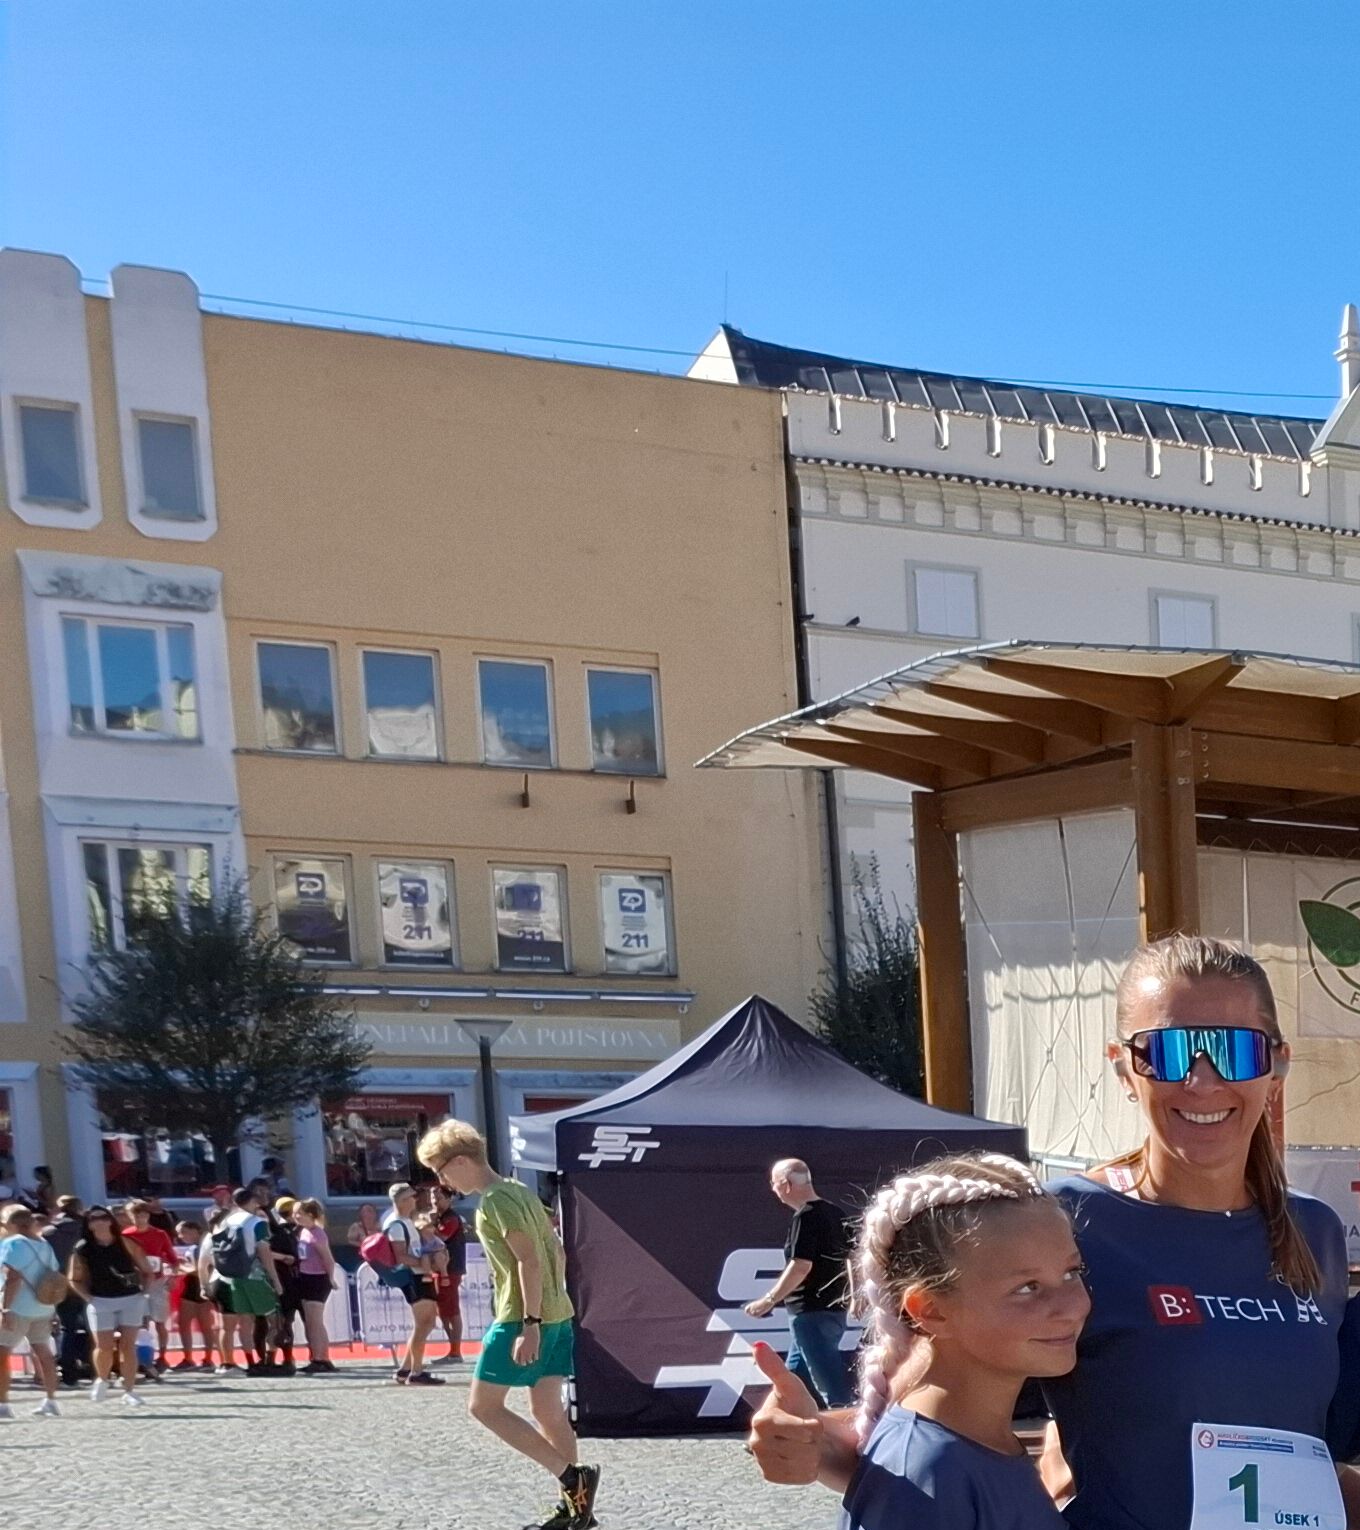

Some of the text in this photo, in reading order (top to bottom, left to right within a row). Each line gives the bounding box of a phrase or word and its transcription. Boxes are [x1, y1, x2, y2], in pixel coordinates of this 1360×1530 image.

[621, 932, 649, 949] 211
[1229, 1463, 1259, 1523] 1
[1274, 1509, 1320, 1527] ÚSEK 1
